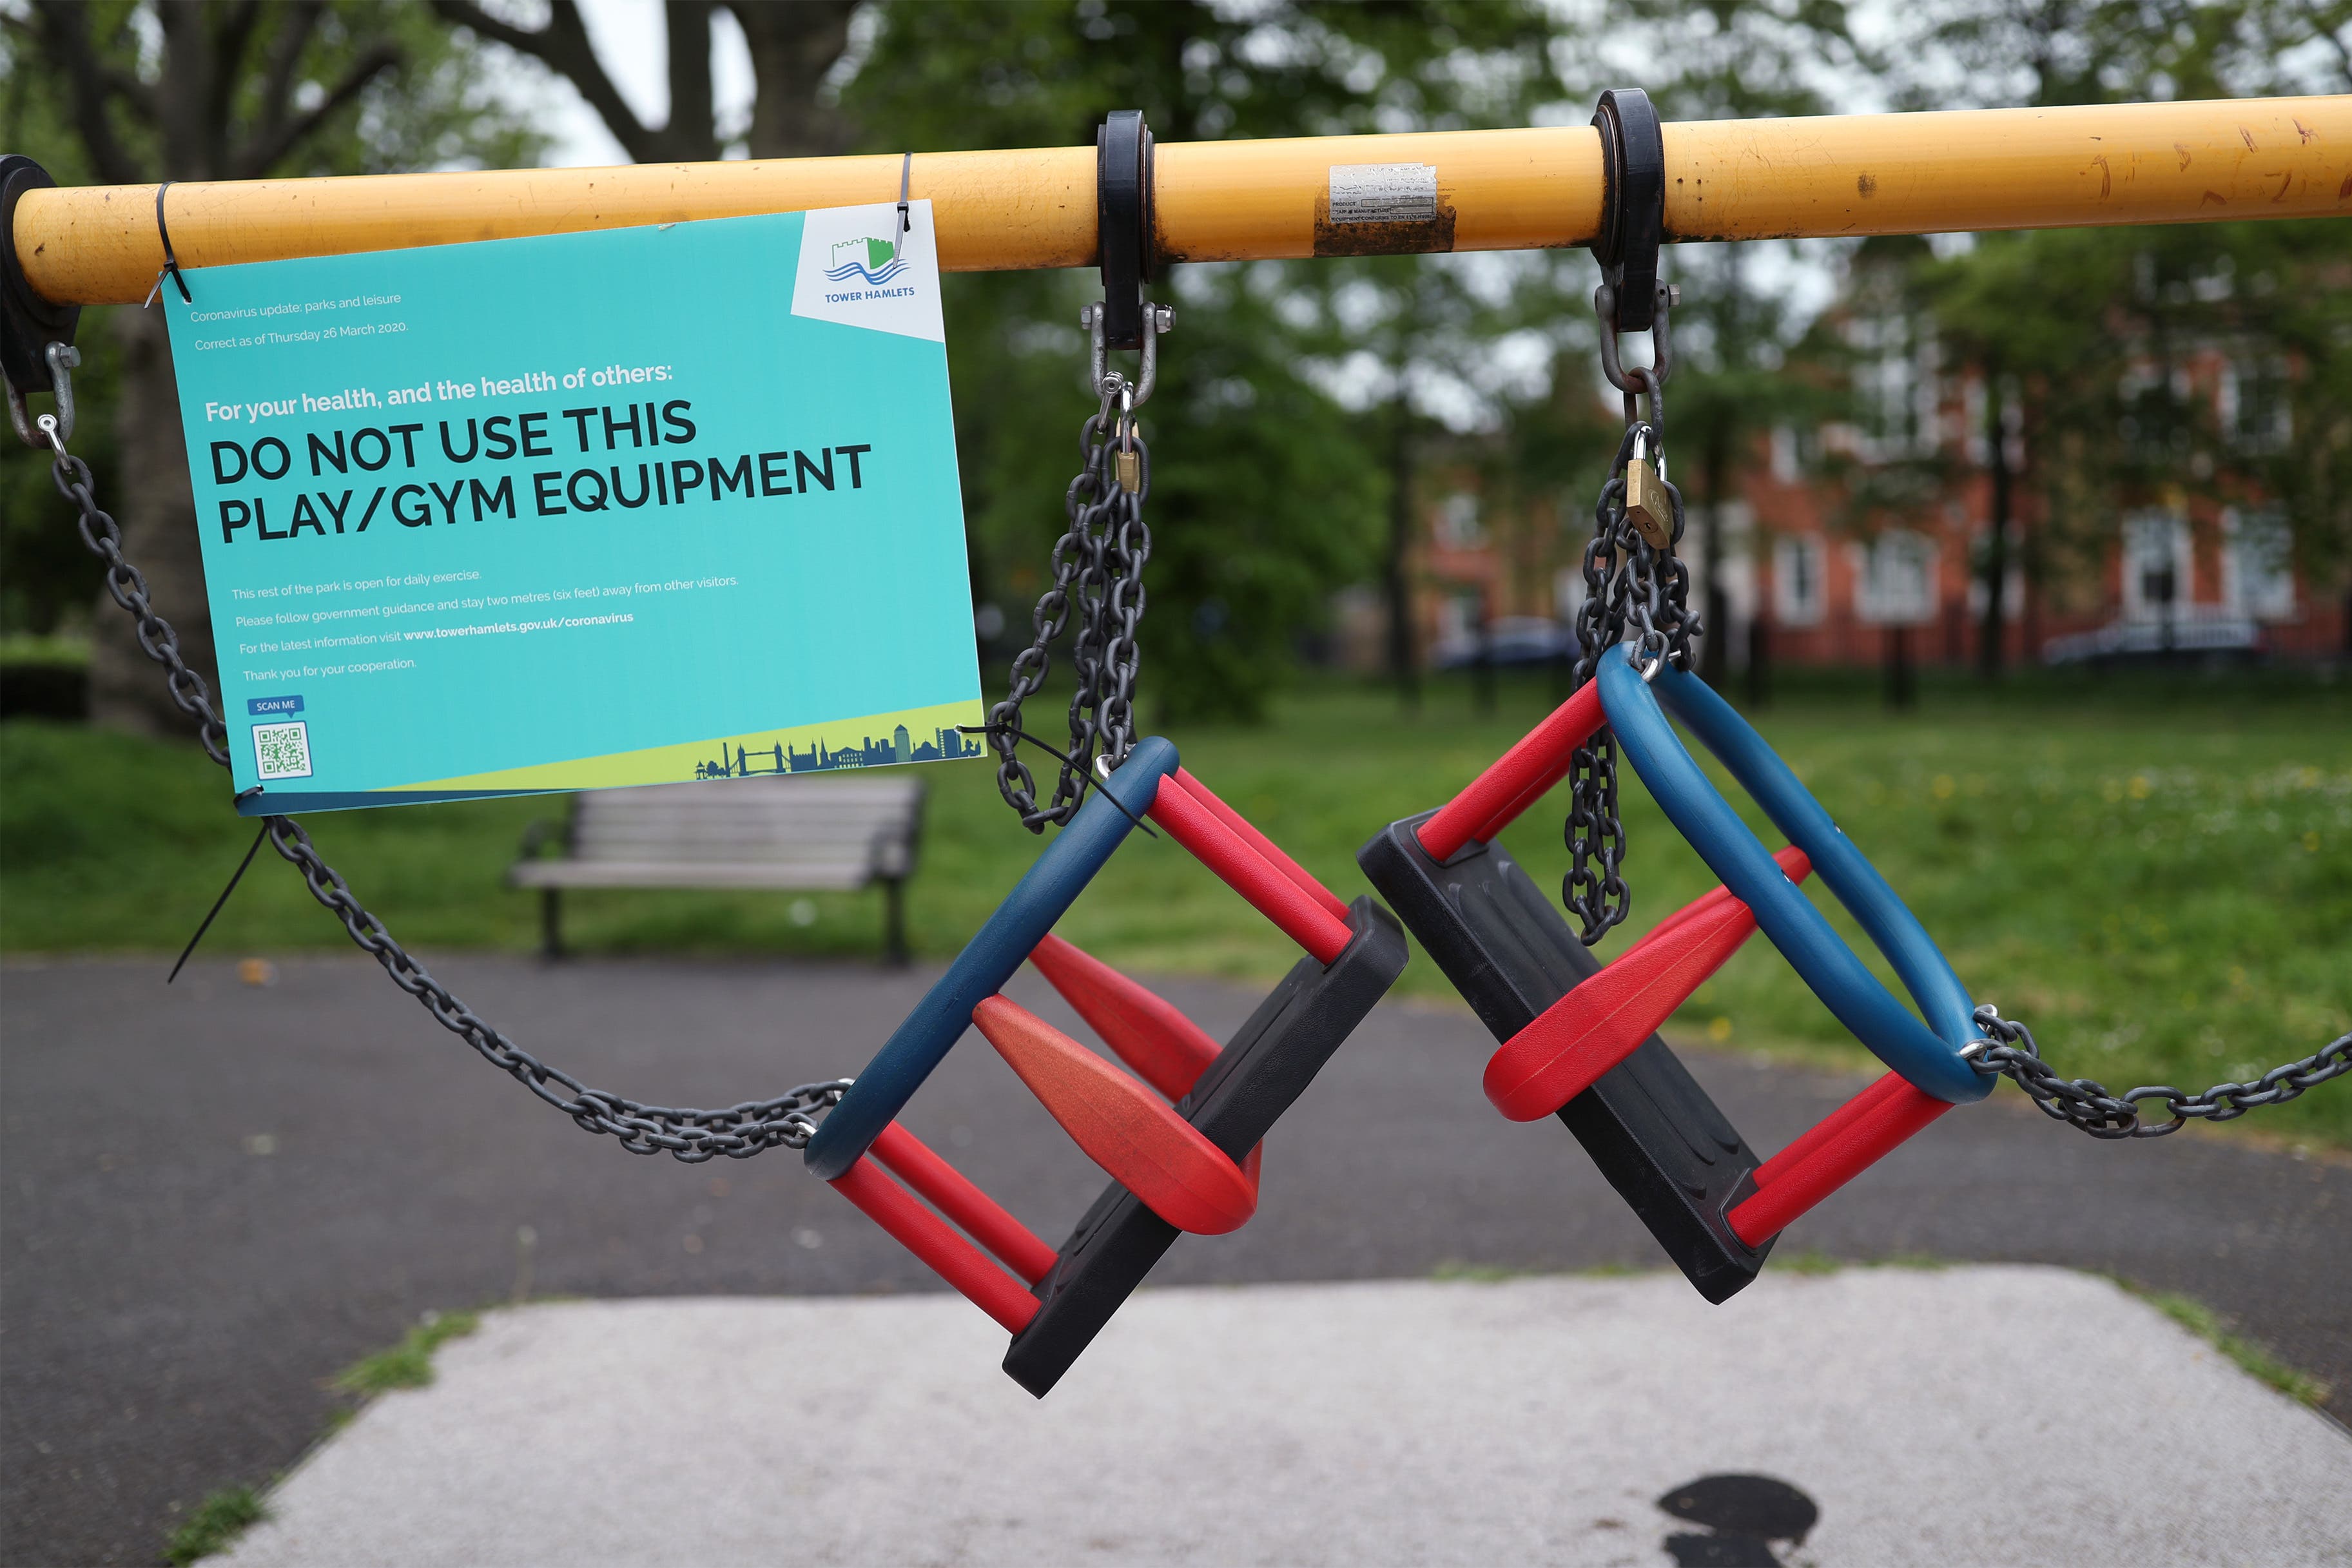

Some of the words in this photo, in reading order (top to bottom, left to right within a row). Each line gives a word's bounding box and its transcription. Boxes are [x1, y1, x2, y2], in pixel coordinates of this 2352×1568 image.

[191, 307, 258, 322] Coronavirus
[260, 303, 302, 318] update:
[305, 299, 336, 314] parks
[339, 296, 361, 308] and
[363, 295, 402, 305] leisure
[825, 292, 862, 303] TOWER
[865, 287, 914, 299] HAMLETS
[195, 337, 237, 350] Correct
[238, 338, 251, 346] as
[255, 334, 266, 345] of
[267, 330, 320, 343] Thursday
[324, 327, 336, 338] 26
[340, 324, 374, 336] March
[378, 322, 408, 333] 2020.
[206, 402, 242, 421] For
[246, 400, 296, 423] your
[302, 388, 382, 412] health,
[388, 382, 432, 405] and
[437, 380, 476, 400] the
[481, 371, 557, 396] health
[563, 367, 587, 389] of
[592, 365, 672, 386] others:
[210, 437, 291, 485] DO
[307, 423, 423, 476] NOT
[439, 412, 552, 463] USE
[563, 400, 696, 452] THIS
[219, 476, 516, 543] PLAY/GYM
[533, 444, 871, 516] EQUIPMENT
[232, 588, 255, 599] This
[258, 586, 278, 597] rest
[281, 585, 292, 595] of
[295, 584, 313, 594] the
[316, 581, 340, 595] park
[343, 580, 352, 590] is
[355, 579, 384, 591] open
[387, 576, 401, 586] for
[404, 574, 431, 586] daily
[433, 570, 481, 583] exercise.
[236, 616, 273, 626] Please
[275, 612, 309, 624] follow
[312, 606, 380, 623] government
[382, 603, 435, 617] guidance
[438, 599, 459, 610] and
[462, 598, 484, 609] stay
[487, 596, 508, 606] two
[511, 593, 550, 603] metres
[553, 589, 572, 600] (six
[574, 586, 599, 598] feet)
[603, 586, 632, 597] away
[634, 583, 662, 593] from
[664, 579, 694, 590] other
[696, 577, 738, 588] visitors.
[240, 644, 257, 653] For
[260, 643, 278, 652] the
[281, 639, 311, 650] latest
[315, 634, 376, 647] information
[380, 632, 401, 642] visit
[403, 613, 634, 640] www.towerhamlets.gov.uk/coronavirus
[243, 669, 278, 681] Thank
[280, 670, 300, 681] you
[304, 666, 318, 675] for
[320, 666, 345, 677] your
[348, 658, 416, 673] cooperation.
[257, 702, 280, 711] SCAN
[282, 700, 295, 709] ME
